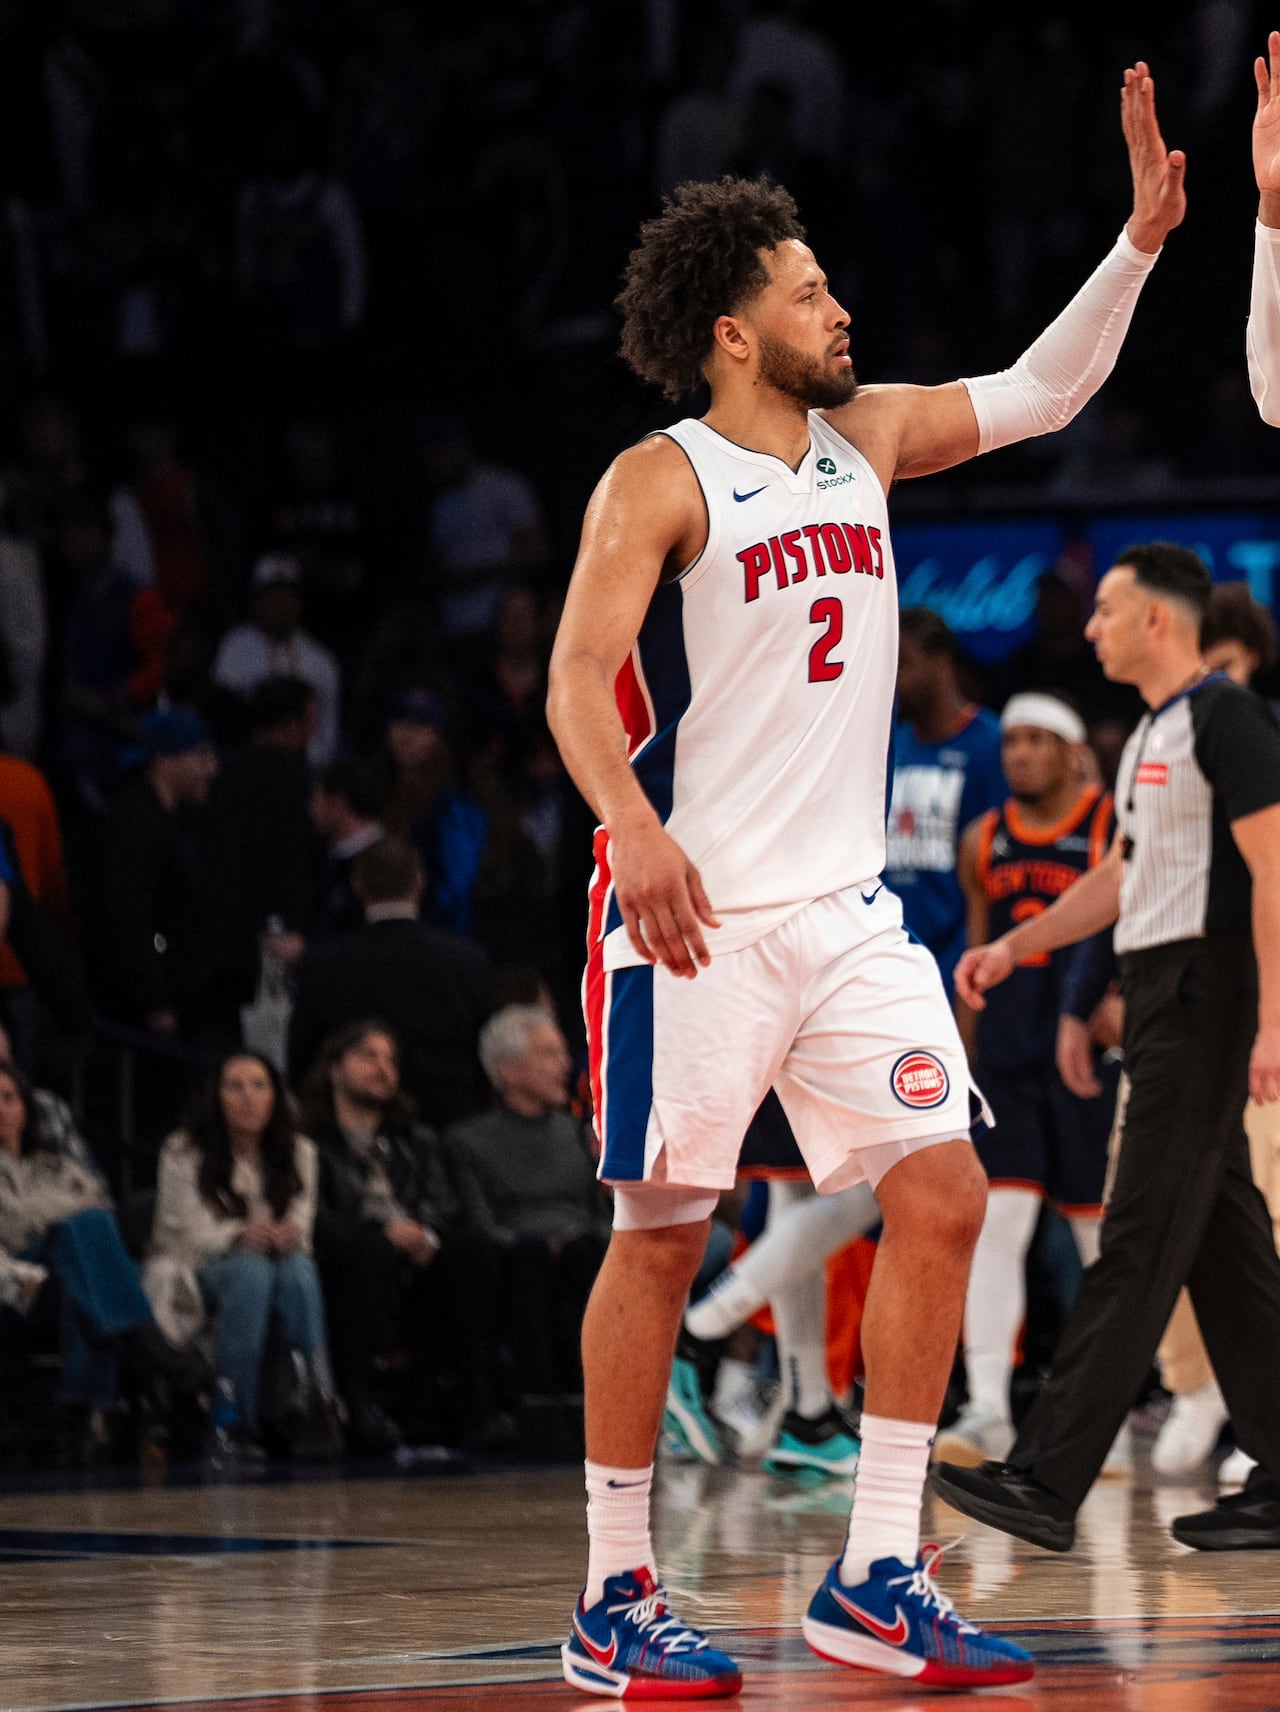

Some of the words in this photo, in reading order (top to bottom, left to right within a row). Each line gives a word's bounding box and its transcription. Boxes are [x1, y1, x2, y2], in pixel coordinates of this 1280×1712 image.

[816, 471, 856, 490] StockX
[736, 523, 884, 603] PISTONS
[808, 597, 844, 683] 2
[901, 1067, 937, 1084] DETROIT
[904, 1078, 941, 1094] PISTONS
